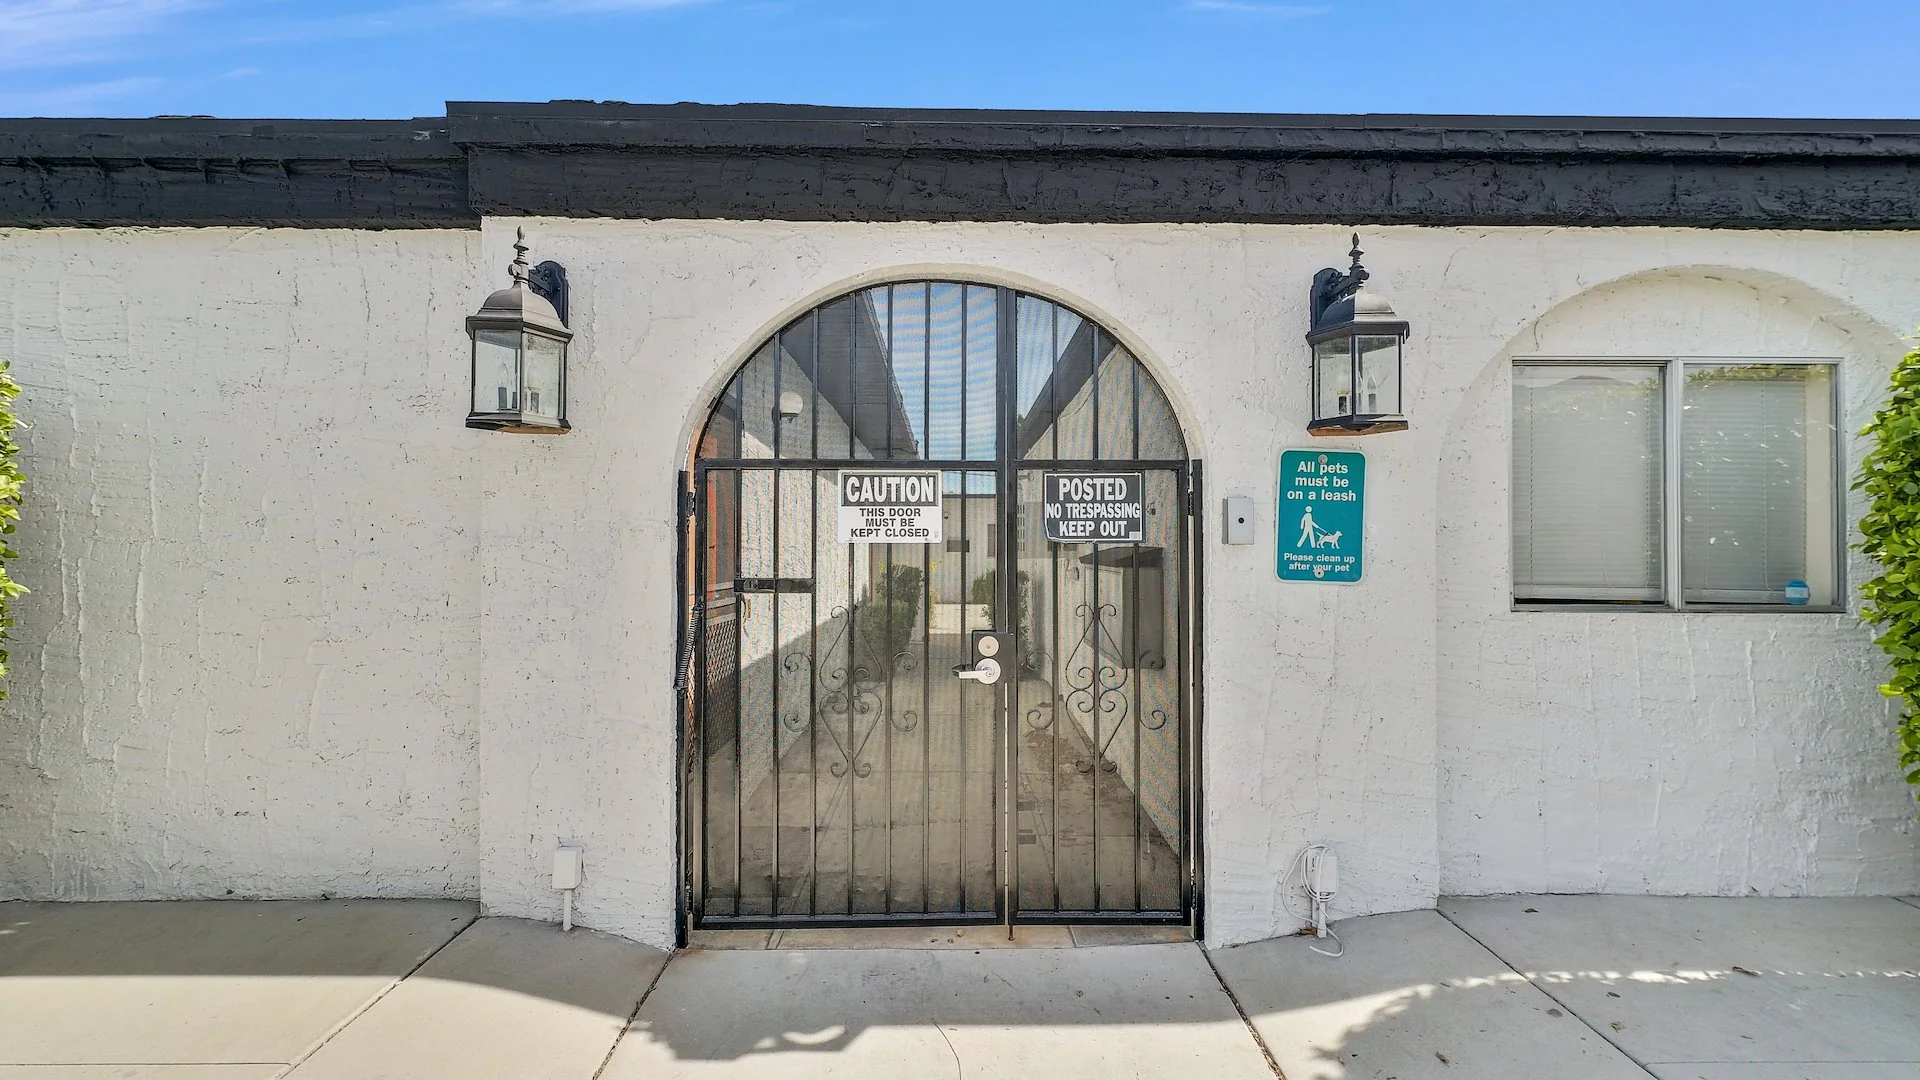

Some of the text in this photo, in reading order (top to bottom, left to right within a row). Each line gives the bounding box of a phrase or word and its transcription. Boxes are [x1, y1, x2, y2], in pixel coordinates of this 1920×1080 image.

[1297, 461, 1349, 475] All pets
[1295, 476, 1349, 487] must be
[846, 476, 934, 503] CAUTION
[1059, 478, 1127, 501] POSTED
[1287, 489, 1357, 502] on a leash
[859, 508, 921, 517] THIS DOOR
[1046, 503, 1140, 519] NO TRESPASSING
[865, 518, 915, 527] MUST BE
[1059, 520, 1127, 537] KEEP OUT
[851, 528, 881, 537] KEPT
[884, 528, 930, 537] CLOSED
[1283, 552, 1355, 564] Please clean up
[1289, 562, 1350, 573] after your pet
